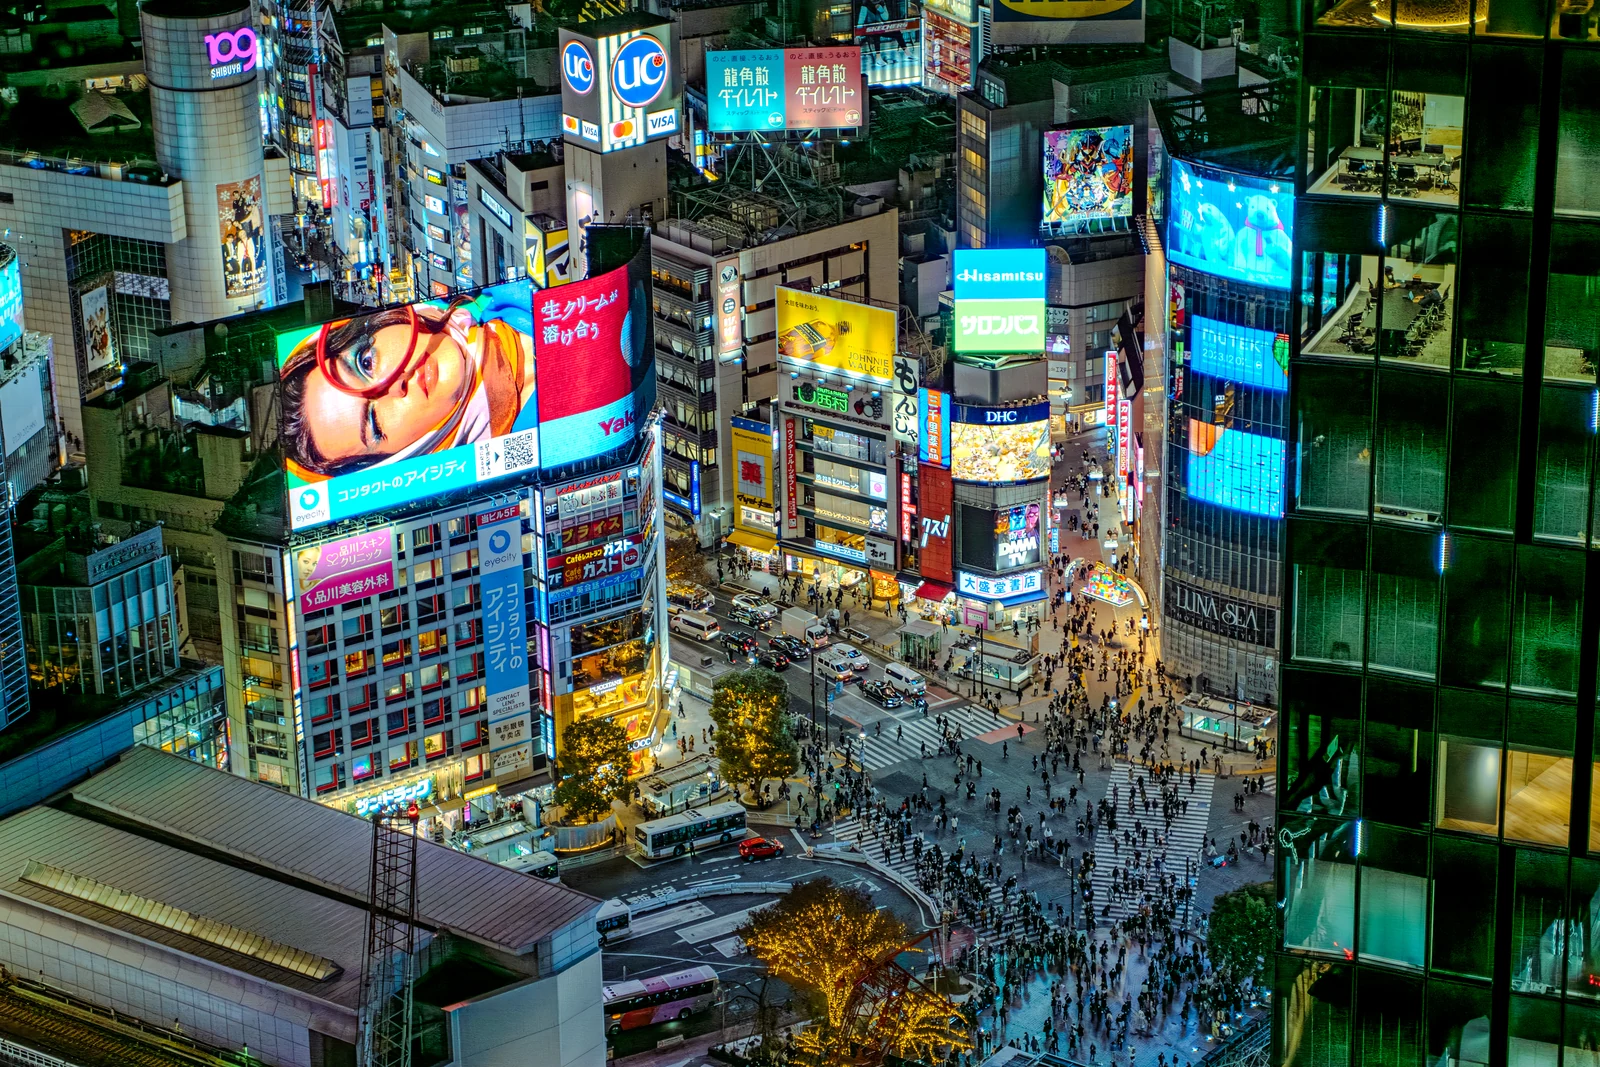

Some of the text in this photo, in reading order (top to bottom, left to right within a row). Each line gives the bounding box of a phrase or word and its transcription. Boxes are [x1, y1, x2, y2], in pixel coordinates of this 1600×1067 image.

[204, 27, 257, 72] 109
[210, 62, 242, 79] SHIBUYA
[565, 53, 591, 82] UC
[618, 52, 663, 89] UC
[724, 66, 769, 87] 龍角散
[801, 63, 846, 84] 龍角散
[583, 126, 598, 137] VISA
[650, 115, 674, 129] VISA
[956, 269, 1043, 282] Hisamitsu
[540, 289, 618, 322] 生クリームが
[542, 320, 600, 346] 溶け合う
[960, 315, 1040, 336] サロンパス
[848, 352, 889, 368] JOHNNIE
[848, 360, 889, 376] WALKER
[817, 393, 849, 413] 西村
[894, 357, 918, 443] もんじゃ
[1107, 385, 1116, 421] カラオケ
[986, 411, 1017, 423] DHC
[1121, 406, 1129, 442] カラオケ
[928, 395, 940, 461] 三千里薬品
[338, 458, 468, 503] コンタクトのアイシティ
[741, 460, 762, 485] 薬
[580, 485, 618, 506] しゃぶ葉
[296, 508, 326, 523] eyecity
[481, 507, 516, 525] 当ビル5F
[545, 504, 558, 514] 9F
[921, 514, 950, 548] クスリ
[339, 537, 387, 557] 品川スキン
[604, 539, 633, 557] ガスト
[999, 537, 1037, 556] DMM
[340, 548, 383, 567] クリニック
[484, 553, 517, 567] eyecity
[1009, 551, 1027, 566] TV
[548, 572, 562, 584] 7F
[583, 557, 619, 579] ガスト
[314, 572, 389, 605] 品川美容外科
[576, 574, 628, 594] 英会話イーオン
[964, 575, 1036, 595] 大盛堂書店
[1176, 586, 1260, 631] LUNA SEA
[486, 587, 506, 673] アイシティ
[506, 584, 523, 670] コンタクトの
[496, 692, 520, 703] CONTACT
[501, 699, 515, 707] LENS
[492, 701, 525, 715] SPECIALISTS
[355, 779, 432, 817] サンドラッグ
